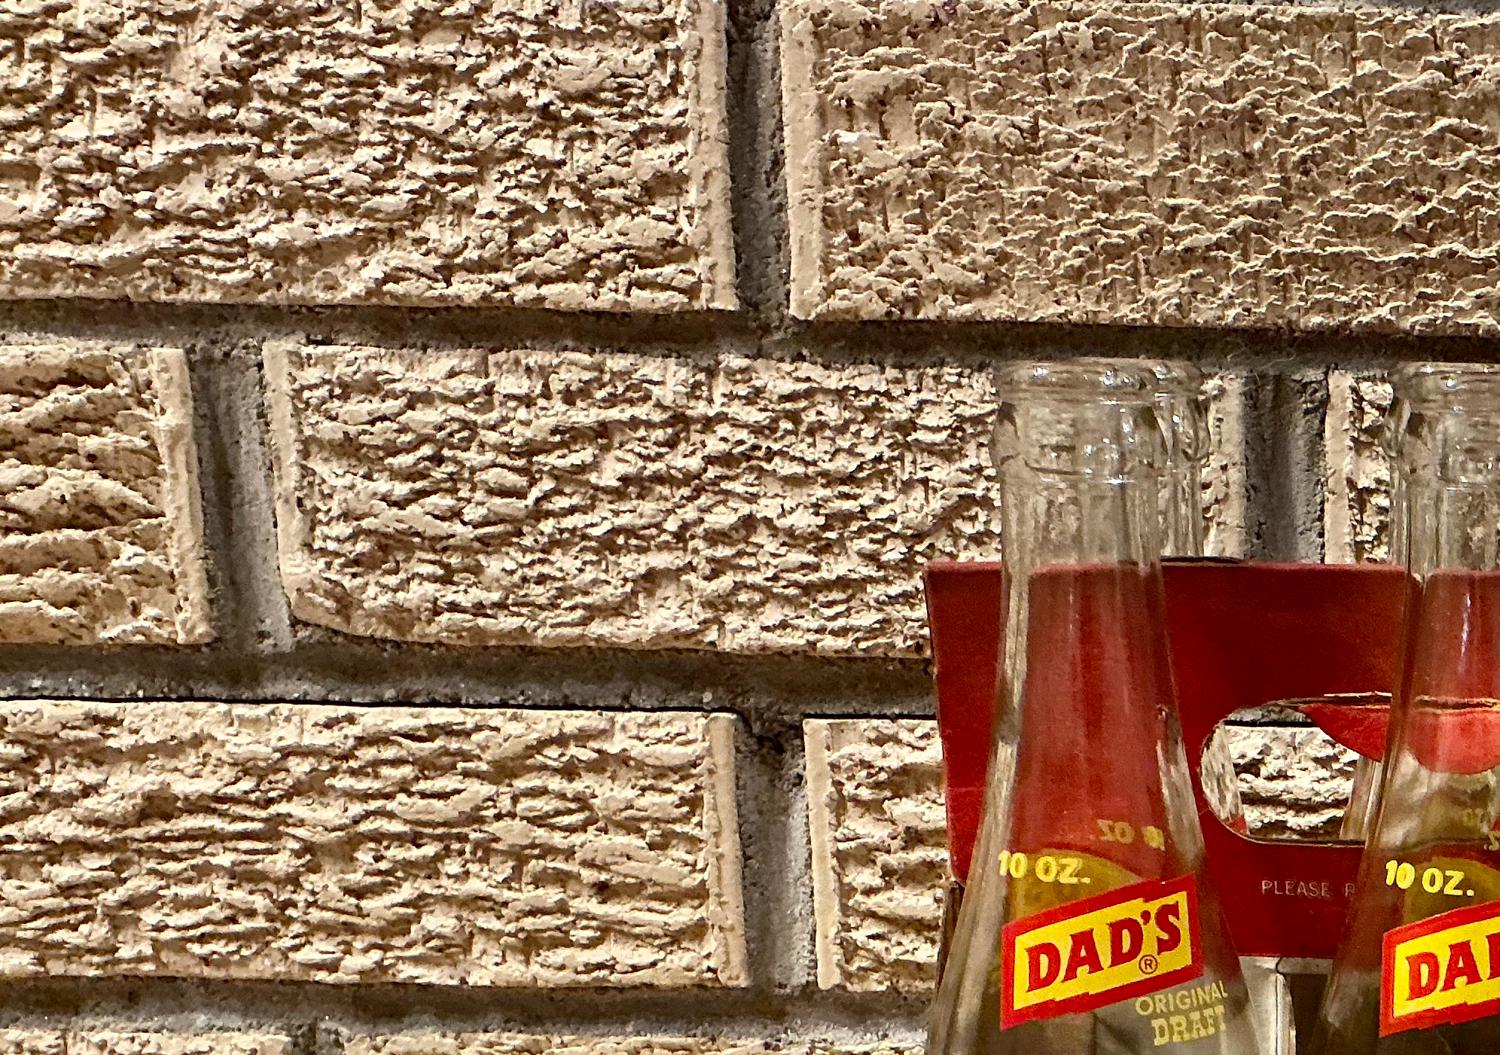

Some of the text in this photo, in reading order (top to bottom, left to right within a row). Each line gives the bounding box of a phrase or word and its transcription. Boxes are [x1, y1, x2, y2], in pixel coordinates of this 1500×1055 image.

[999, 851, 1090, 884] 10 OZ.
[1385, 860, 1475, 896] 10 OZ.
[1261, 879, 1330, 897] PLEASE
[1026, 900, 1182, 992] DAD'S
[1135, 980, 1228, 1015] ORIGINAL
[1151, 1005, 1226, 1046] DRAFT
